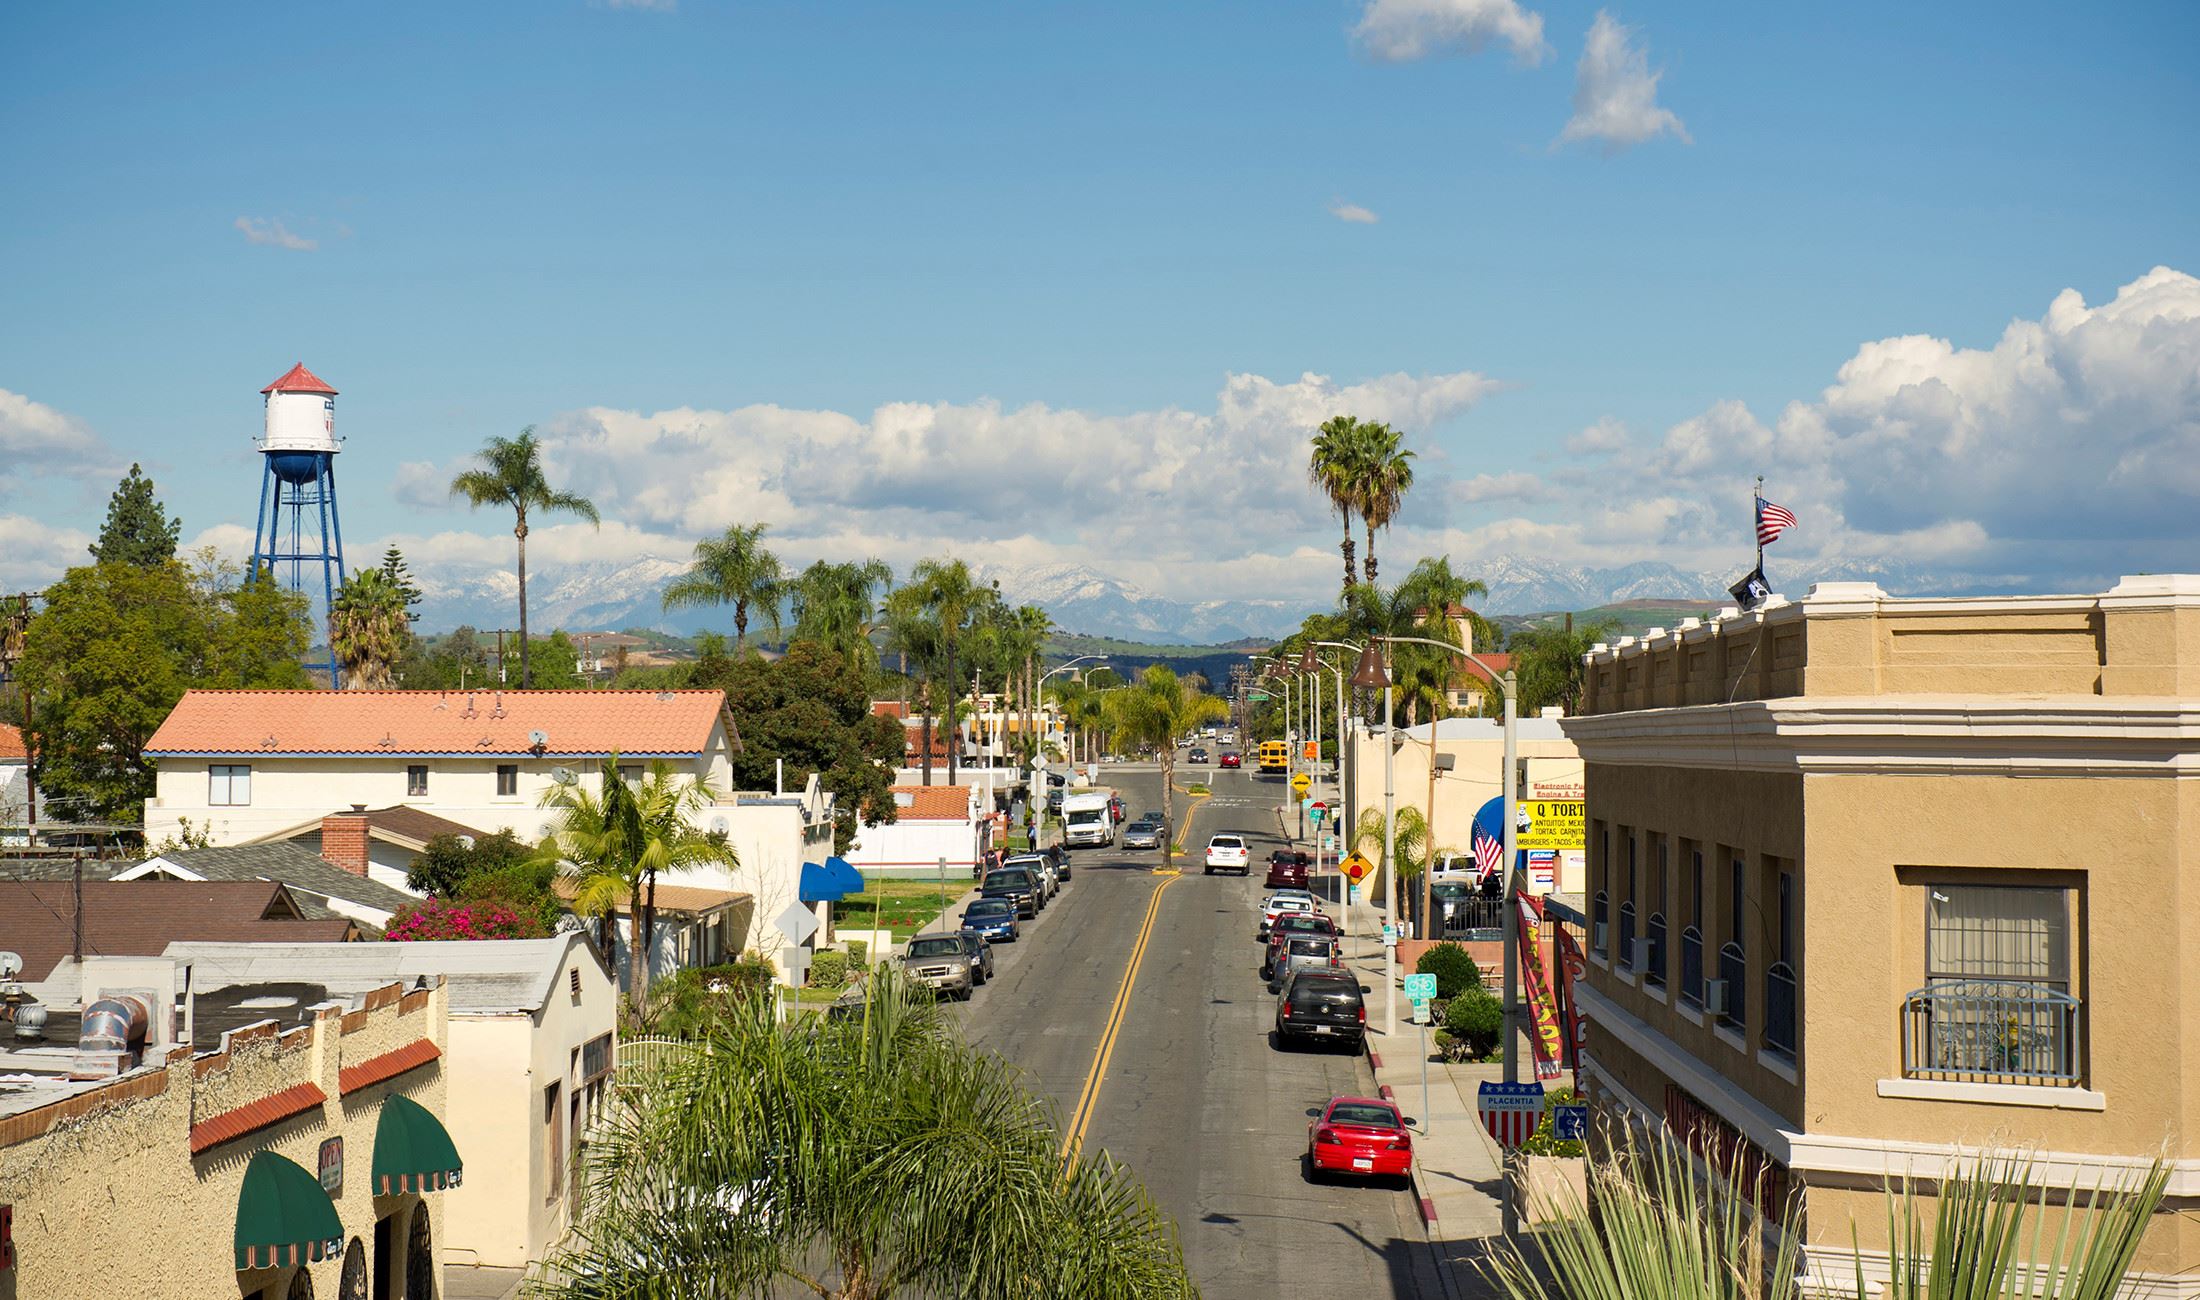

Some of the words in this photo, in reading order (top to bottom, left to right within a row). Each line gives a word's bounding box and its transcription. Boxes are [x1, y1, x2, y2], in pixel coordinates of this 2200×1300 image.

[1538, 804, 1546, 817] Q
[1552, 804, 1585, 816] TORT
[322, 1142, 340, 1168] OPEN
